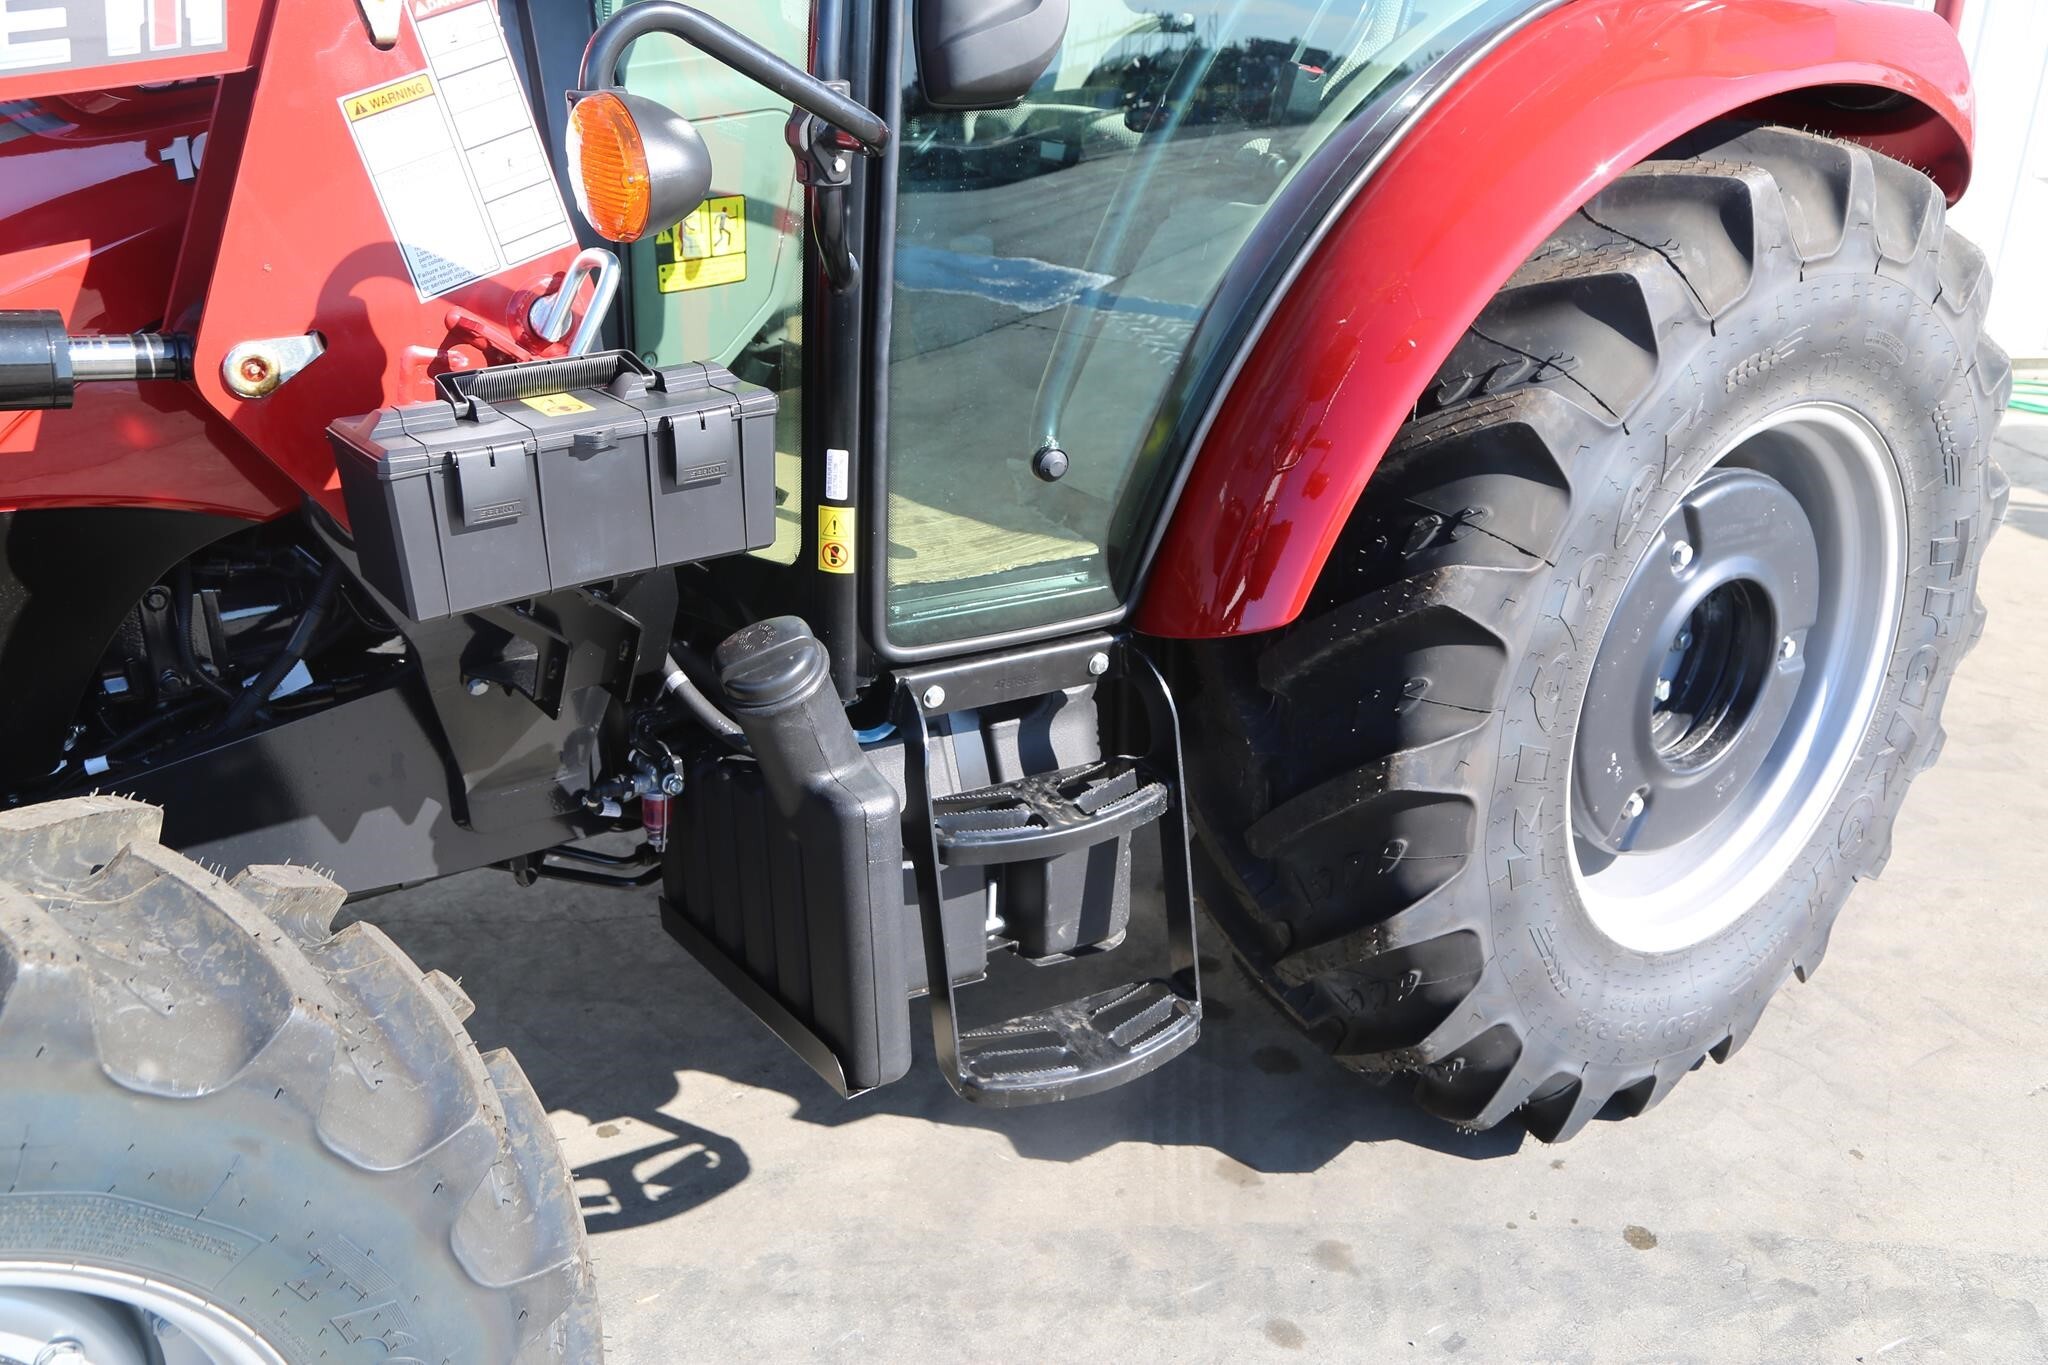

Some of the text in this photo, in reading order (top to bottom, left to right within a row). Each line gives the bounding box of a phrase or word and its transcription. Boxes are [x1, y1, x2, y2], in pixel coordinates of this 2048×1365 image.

[368, 82, 425, 109] WARNING
[418, 269, 438, 279] Failure
[421, 276, 437, 286] could
[438, 269, 453, 278] result
[431, 277, 453, 288] serious
[1808, 515, 1971, 917] Traker
